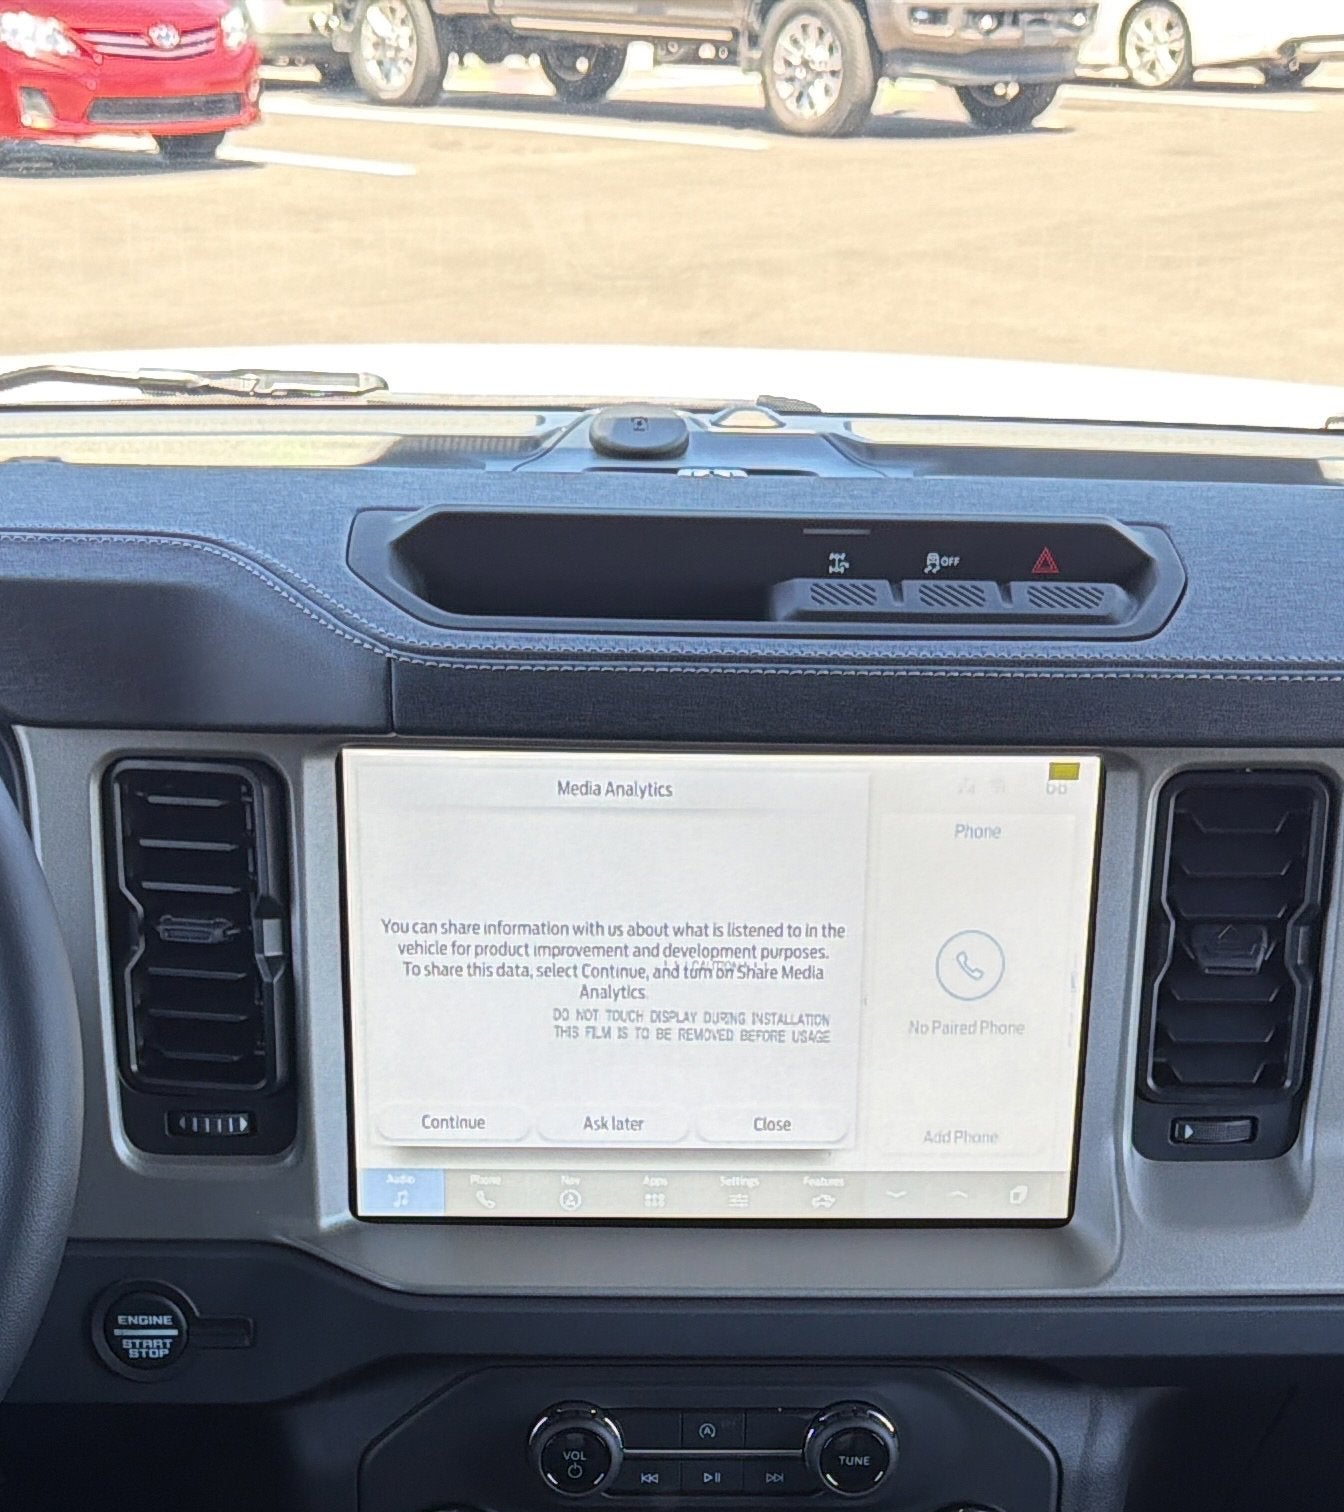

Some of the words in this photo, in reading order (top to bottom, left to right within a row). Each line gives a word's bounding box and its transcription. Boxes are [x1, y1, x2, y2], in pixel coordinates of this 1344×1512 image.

[940, 556, 960, 567] OFF
[557, 780, 602, 796] Media
[605, 780, 673, 800] Analytics
[954, 823, 1002, 840] Phone
[381, 918, 409, 934] You
[412, 922, 437, 934] can
[441, 919, 480, 935] share
[484, 920, 569, 936] information
[573, 921, 604, 936] with
[608, 924, 623, 937] us
[627, 922, 669, 937] about
[673, 922, 709, 937] what
[713, 922, 724, 937] is
[727, 922, 784, 938] listened
[787, 924, 802, 938] to
[805, 923, 818, 938] in
[821, 922, 846, 938] the
[398, 940, 447, 955] vehicle
[452, 940, 470, 956] for
[474, 941, 529, 958] product
[533, 943, 629, 960] improvement
[632, 943, 660, 958] and
[663, 943, 757, 961] development
[760, 946, 830, 961] purposes.
[403, 961, 421, 976] To
[424, 961, 463, 977] share
[467, 962, 493, 977] this
[496, 962, 534, 979] data,
[536, 963, 578, 978] select
[581, 963, 649, 981] Continue,
[652, 964, 680, 979] and
[684, 965, 713, 980] turn
[716, 967, 734, 980] on
[736, 964, 778, 980] Share
[782, 965, 824, 980] Media
[579, 984, 646, 1002] Analytics
[553, 1008, 569, 1021] DO
[576, 1008, 599, 1021] NOT
[606, 1009, 644, 1022] TOUCH
[651, 1010, 697, 1023] DISPLAY
[704, 1011, 746, 1025] DURING
[752, 1012, 831, 1026] INSTALLATION
[555, 1025, 579, 1039] THIS
[585, 1026, 611, 1039] FILM
[617, 1026, 628, 1039] IS
[635, 1027, 650, 1040] TO
[656, 1027, 671, 1041] BE
[678, 1028, 734, 1041] REMOVED
[740, 1029, 786, 1042] BEFORE
[792, 1030, 831, 1043] USAGE
[908, 1019, 929, 1035] No
[932, 1020, 977, 1036] Paired
[980, 1020, 1025, 1036] Phone
[421, 1114, 486, 1131] Continue
[583, 1115, 609, 1131] Ask
[612, 1116, 644, 1132] later
[753, 1116, 792, 1132] Close
[923, 1129, 951, 1144] Add
[954, 1130, 999, 1144] Phone
[470, 1174, 501, 1185] Phone
[561, 1175, 581, 1185] Nav
[642, 1175, 668, 1187] Apps
[720, 1175, 760, 1188] Settings
[803, 1176, 845, 1187] Features
[117, 1315, 173, 1326] ENGINE
[122, 1339, 173, 1349] START
[129, 1349, 170, 1359] STOP
[563, 1451, 587, 1462] VOL
[838, 1455, 871, 1466] TUNE
